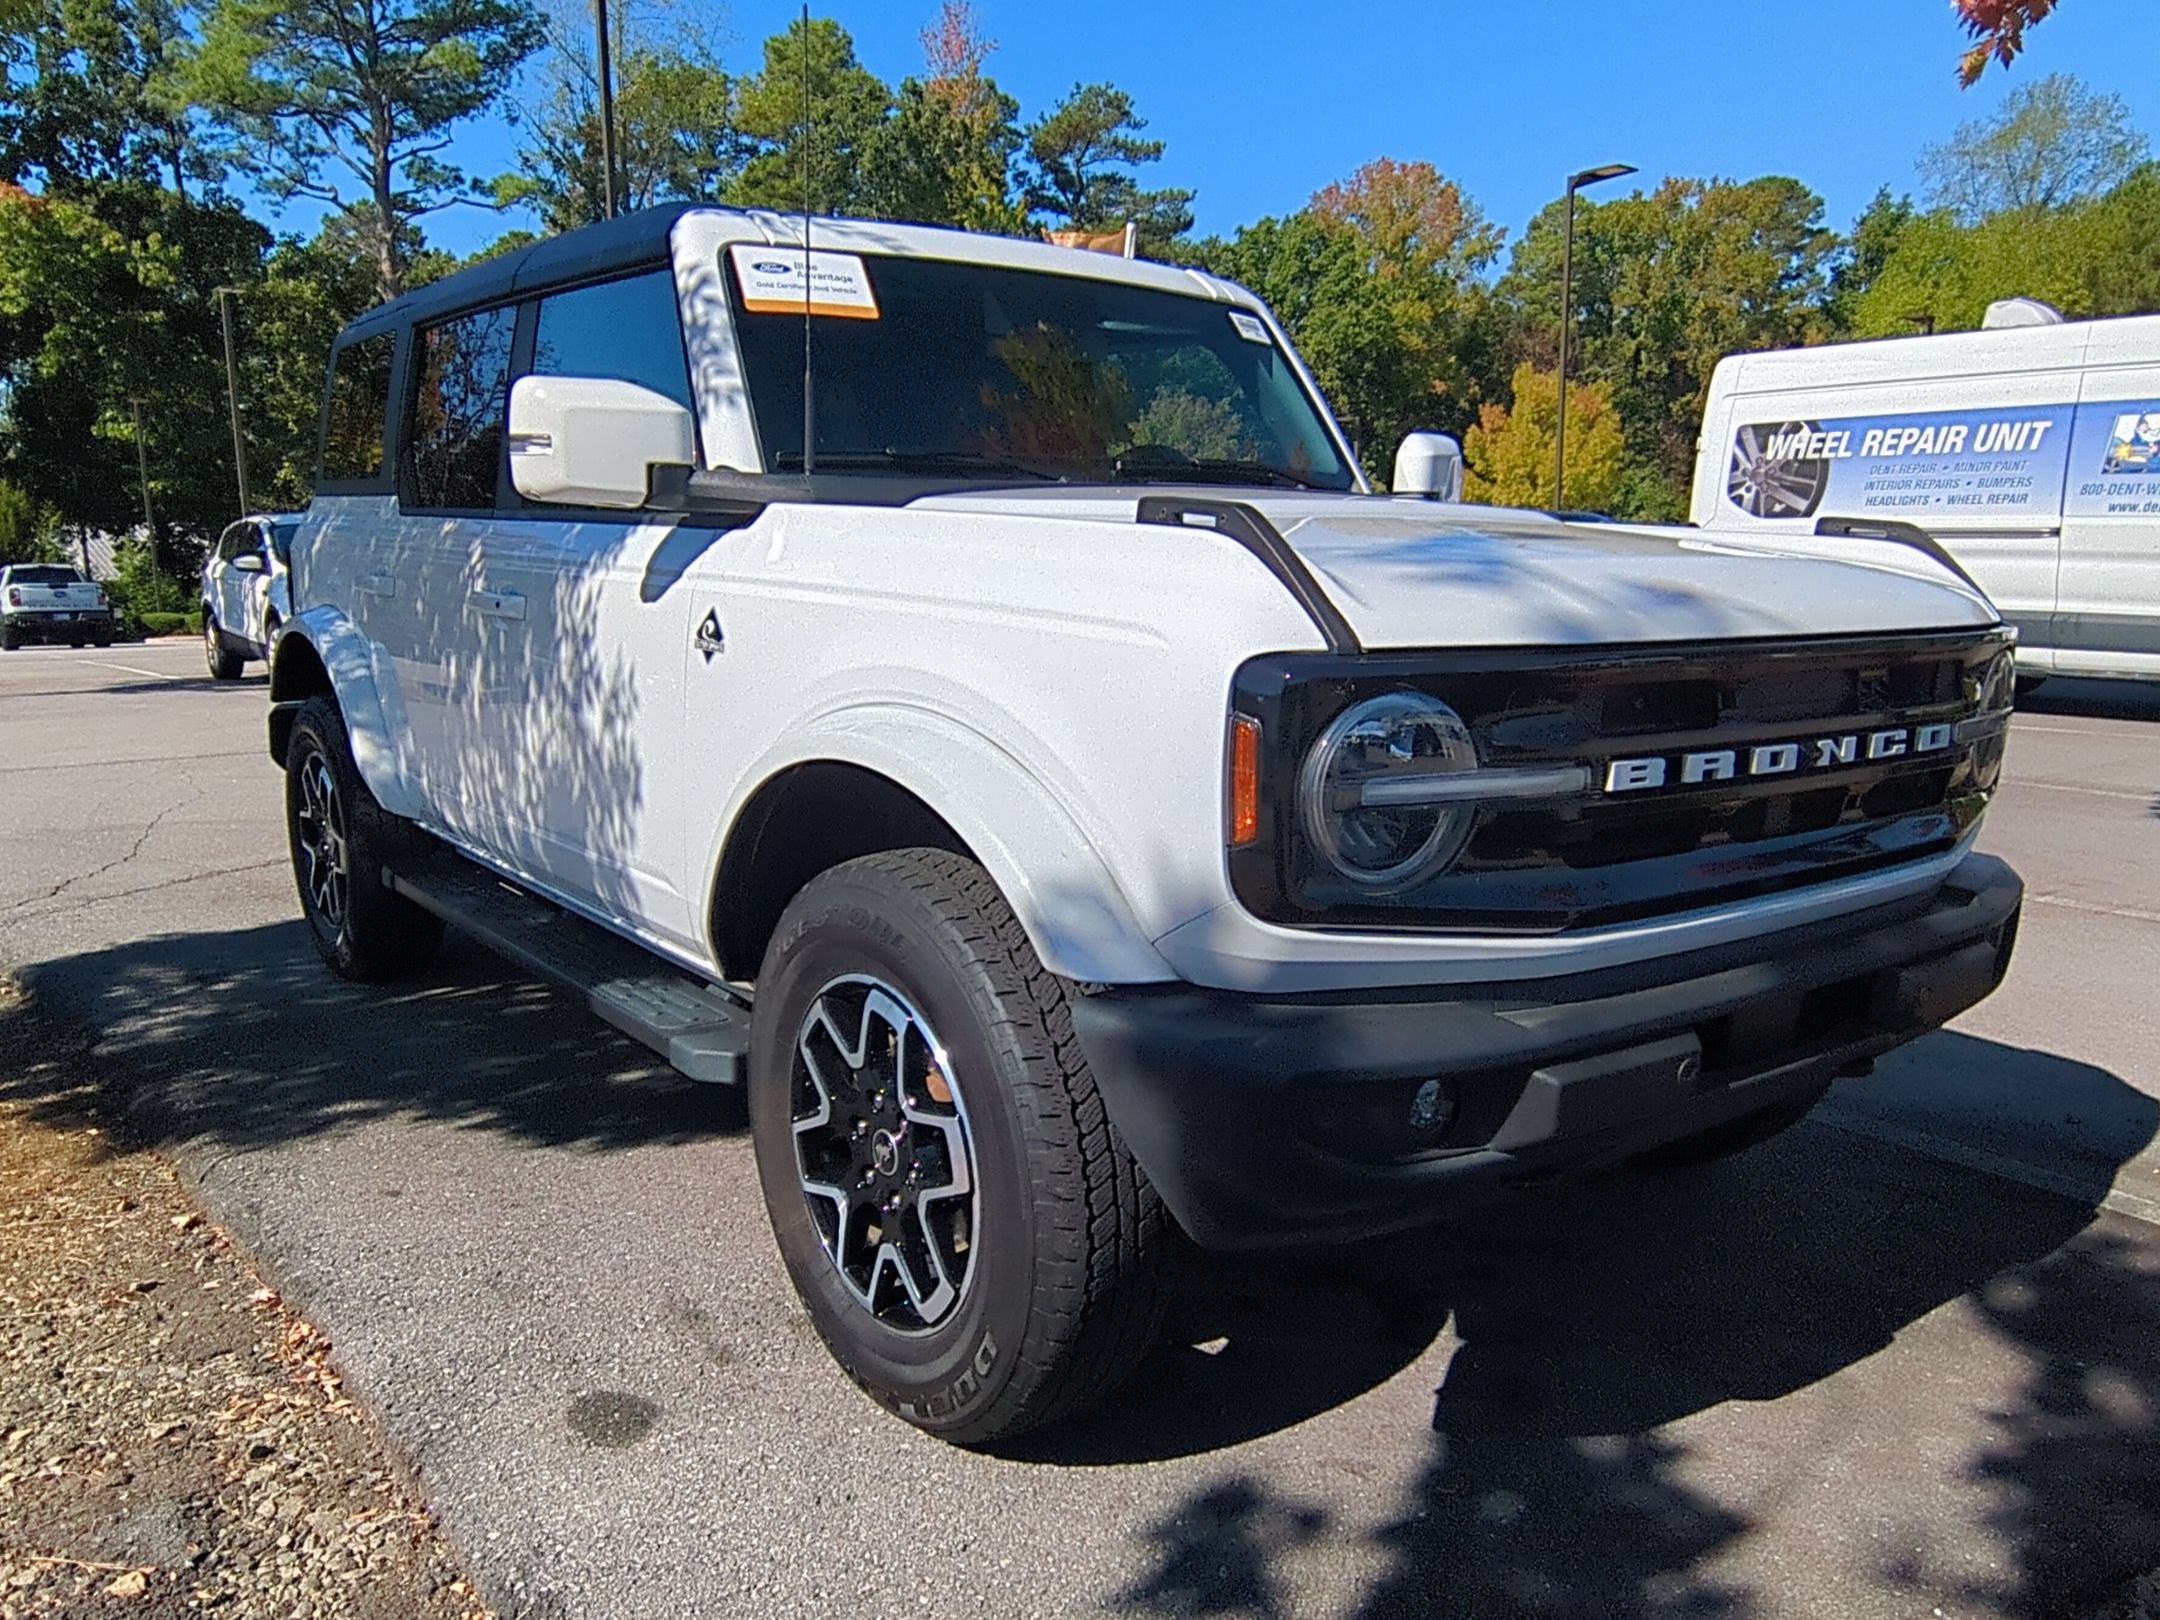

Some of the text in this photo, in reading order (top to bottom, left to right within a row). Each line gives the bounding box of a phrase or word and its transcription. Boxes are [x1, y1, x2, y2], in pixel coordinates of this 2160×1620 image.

[797, 271, 853, 283] Avantage
[1766, 421, 2053, 460] WHEEL REPAIR UNIT
[1869, 459, 2029, 475] DENT REPAIR MINOR PAINT
[1864, 477, 2034, 491] INTERIOR REPAIRS BUMPERS
[1864, 493, 2029, 506] HEADLIGHTS WHEEL REPAIR
[1604, 723, 1952, 793] BRONCO
